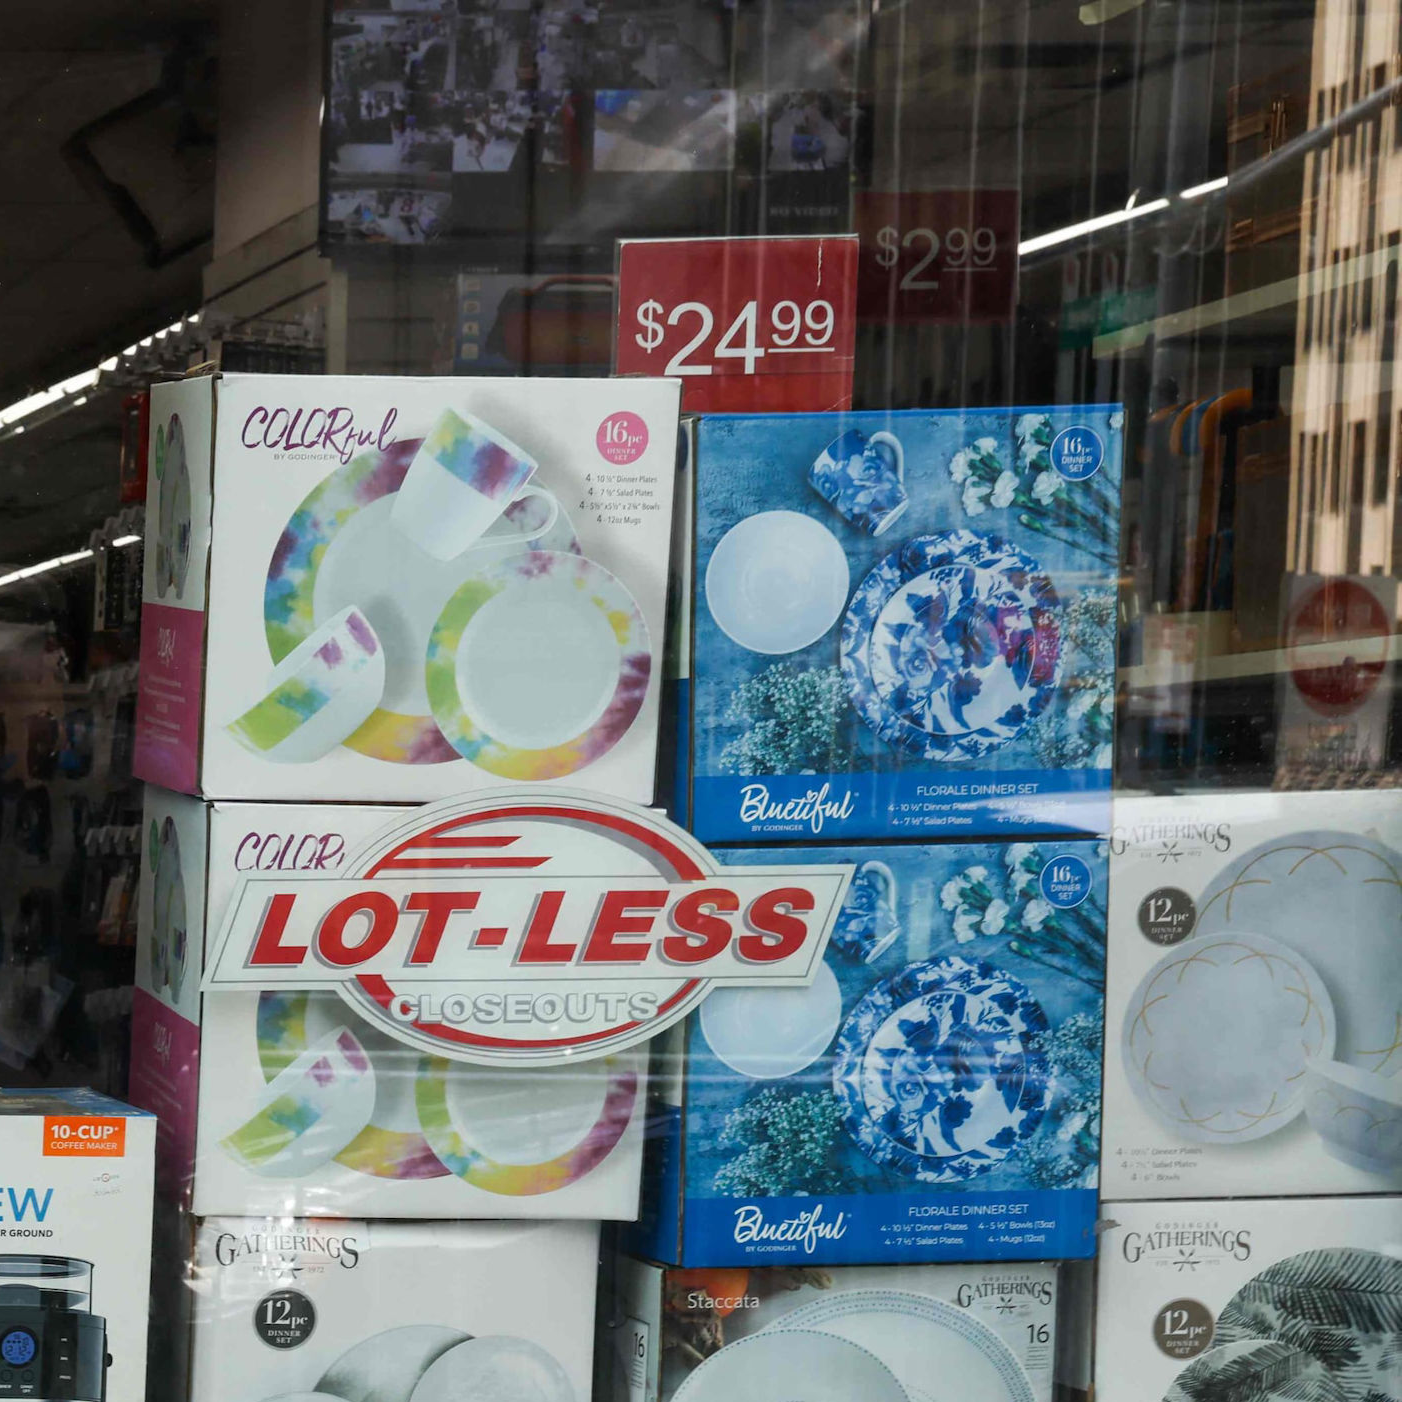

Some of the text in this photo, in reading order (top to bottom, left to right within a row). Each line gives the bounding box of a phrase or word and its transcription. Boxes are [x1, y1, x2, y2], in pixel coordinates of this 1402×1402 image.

[917, 784, 1038, 796] FLORALE DINNER SET
[1110, 823, 1231, 857] GATHERINGS
[243, 886, 816, 970] LOT-LESS
[390, 991, 659, 1025] CLOSEOUTS
[51, 1125, 114, 1139] 10-CUP
[51, 1141, 117, 1150] COFFEE MAKER
[908, 1204, 1029, 1217] FLORALE DINNER SET
[9, 1230, 53, 1238] GROUND
[215, 1232, 359, 1269] GATHERINGS
[1122, 1230, 1252, 1264] GATHERINGS
[687, 1293, 760, 1309] Staccata
[957, 1281, 1052, 1309] GATHERINGS
[1026, 1323, 1050, 1344] 16
